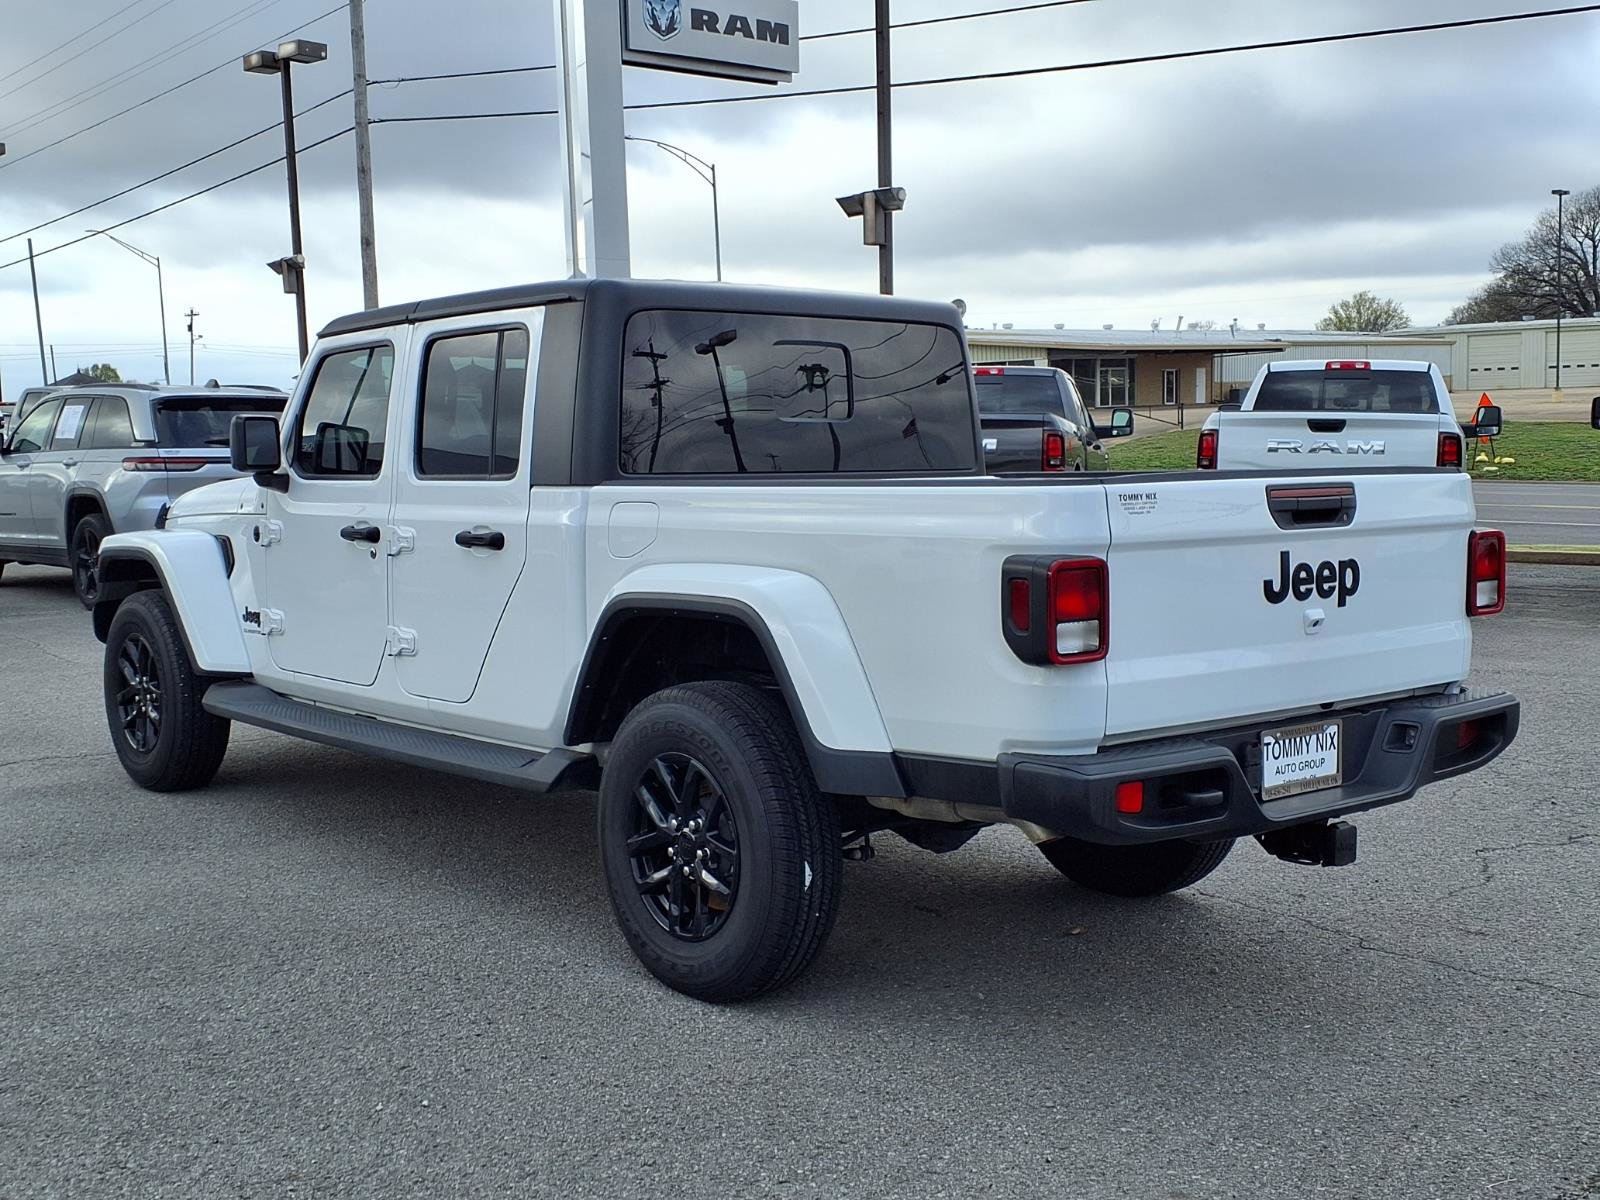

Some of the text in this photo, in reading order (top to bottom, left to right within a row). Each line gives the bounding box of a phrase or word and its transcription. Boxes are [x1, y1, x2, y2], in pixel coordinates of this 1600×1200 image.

[691, 8, 789, 45] RAM
[1267, 439, 1385, 454] RAM
[1118, 493, 1143, 501] TOMMY
[1264, 550, 1360, 607] Jeep
[242, 606, 261, 627] Jeep
[1264, 731, 1336, 761] TOMMY NIX
[1275, 758, 1325, 775] AUTO GROUP
